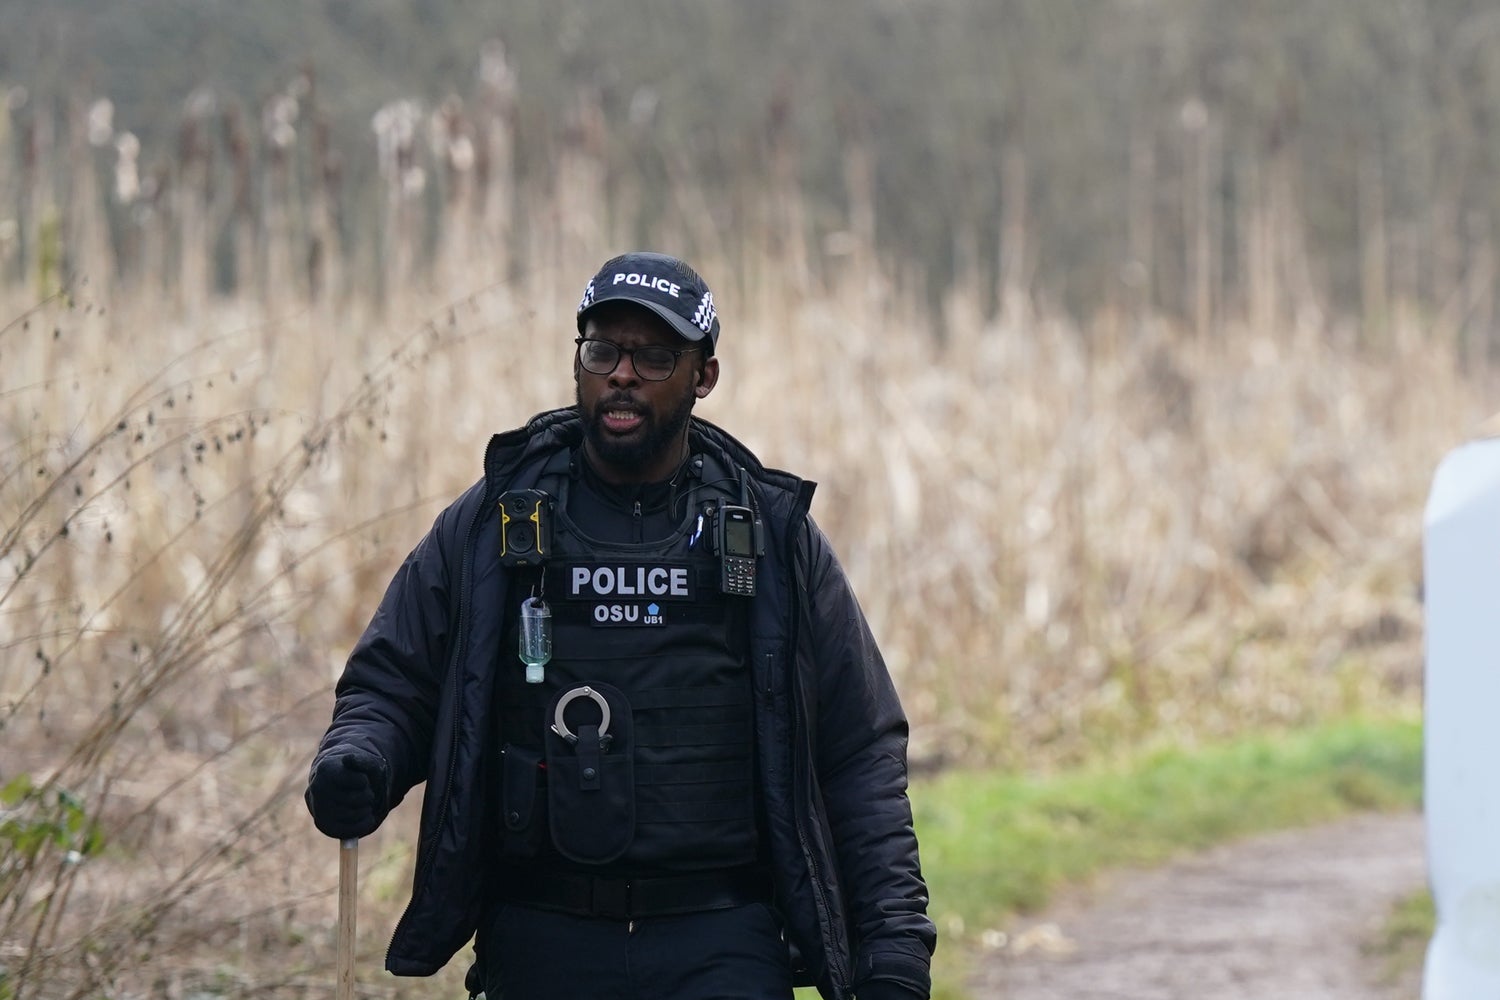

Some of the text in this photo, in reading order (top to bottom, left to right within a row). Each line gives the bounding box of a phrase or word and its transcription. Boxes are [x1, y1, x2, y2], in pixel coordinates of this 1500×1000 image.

[613, 272, 681, 298] POLICE
[572, 567, 689, 596] POLICE
[594, 604, 663, 624] OSU UB1
